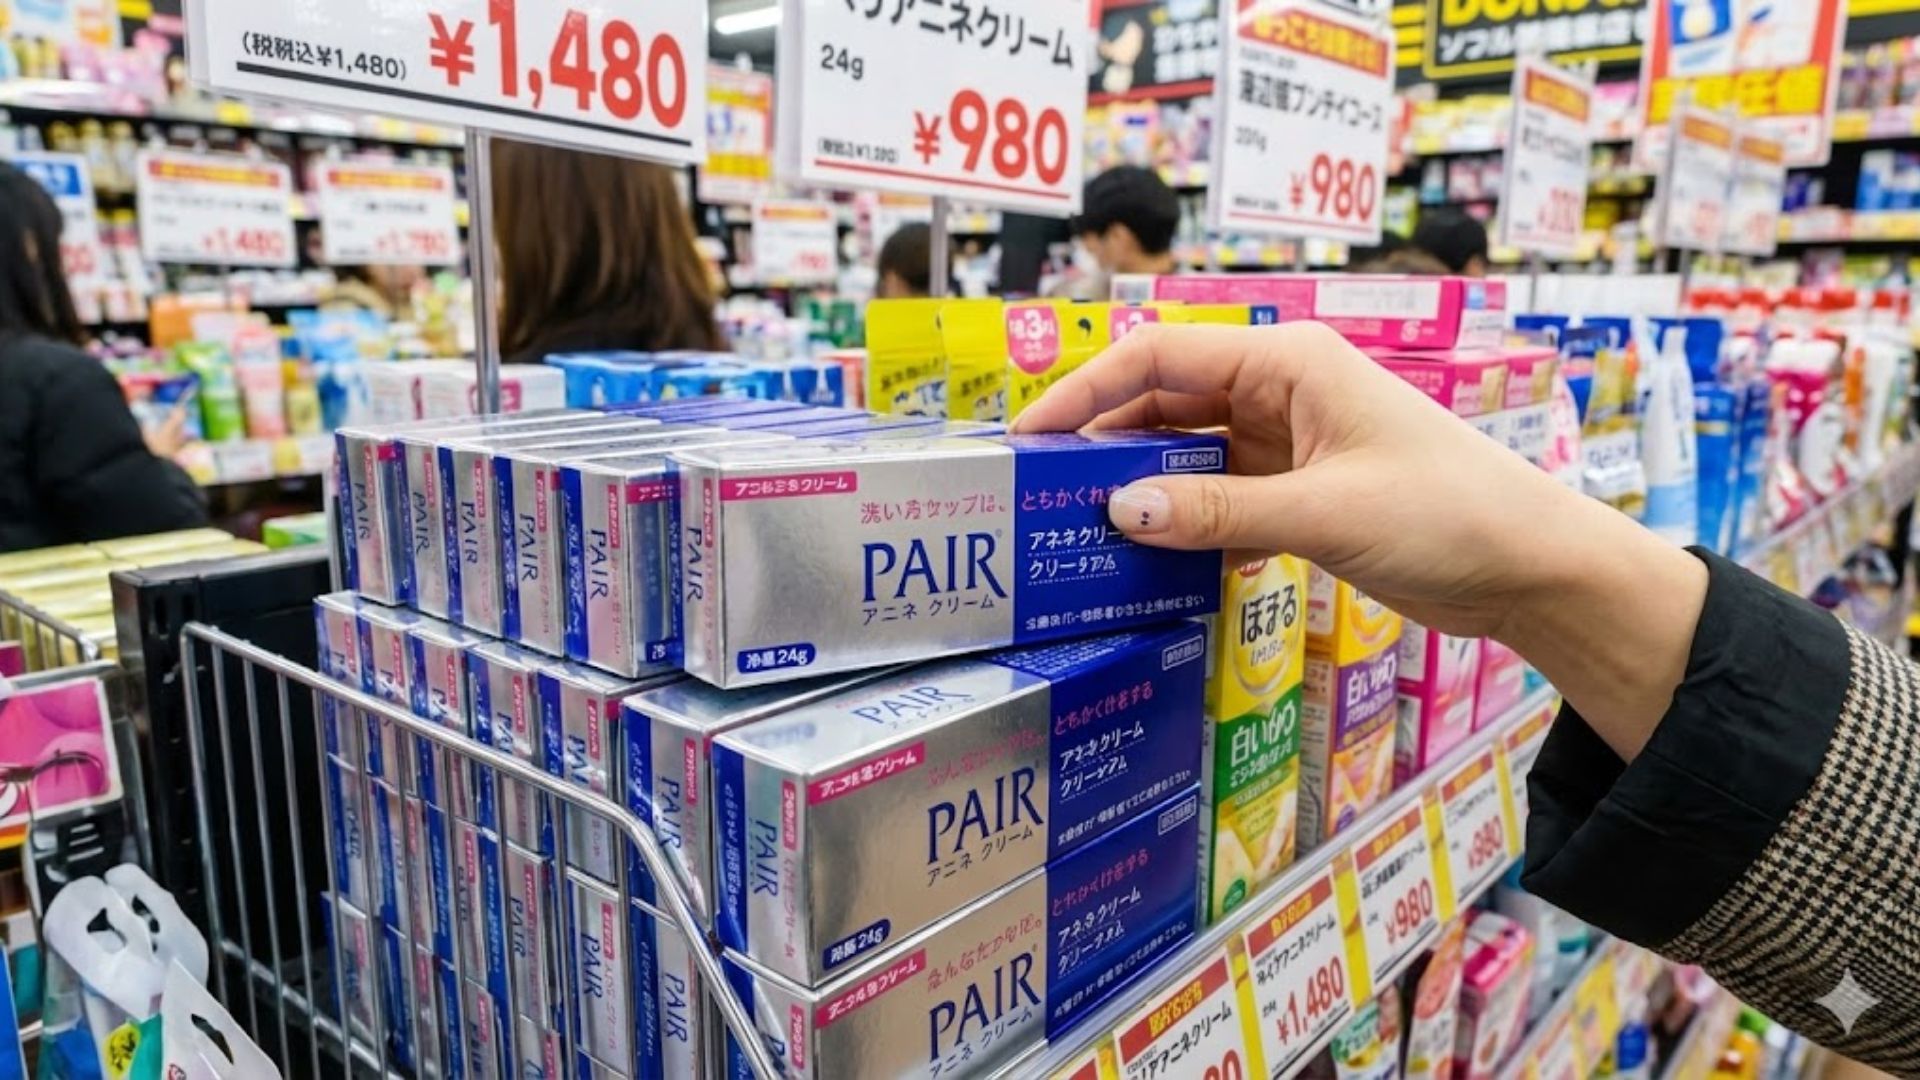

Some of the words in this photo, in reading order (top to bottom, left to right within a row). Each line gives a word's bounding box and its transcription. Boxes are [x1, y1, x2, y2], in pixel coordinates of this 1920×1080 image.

[821, 44, 864, 81] 24g
[914, 89, 1069, 186] ¥980
[1290, 153, 1377, 222] ¥980
[520, 513, 539, 582] PAIR
[590, 528, 609, 600] PAIR
[686, 526, 704, 603] PAIR
[862, 532, 1008, 603] PAIR
[863, 603, 918, 627] アニネ
[929, 593, 995, 617] クリーム
[926, 765, 1045, 866] PAIR
[753, 819, 779, 898] PAIR
[510, 896, 527, 958] PAIR
[1384, 877, 1433, 945] ¥980
[581, 932, 603, 999] PAIR
[1276, 955, 1345, 1046] ¥1,480
[666, 972, 688, 1043] PAIR
[929, 951, 1041, 1063] PAIR
